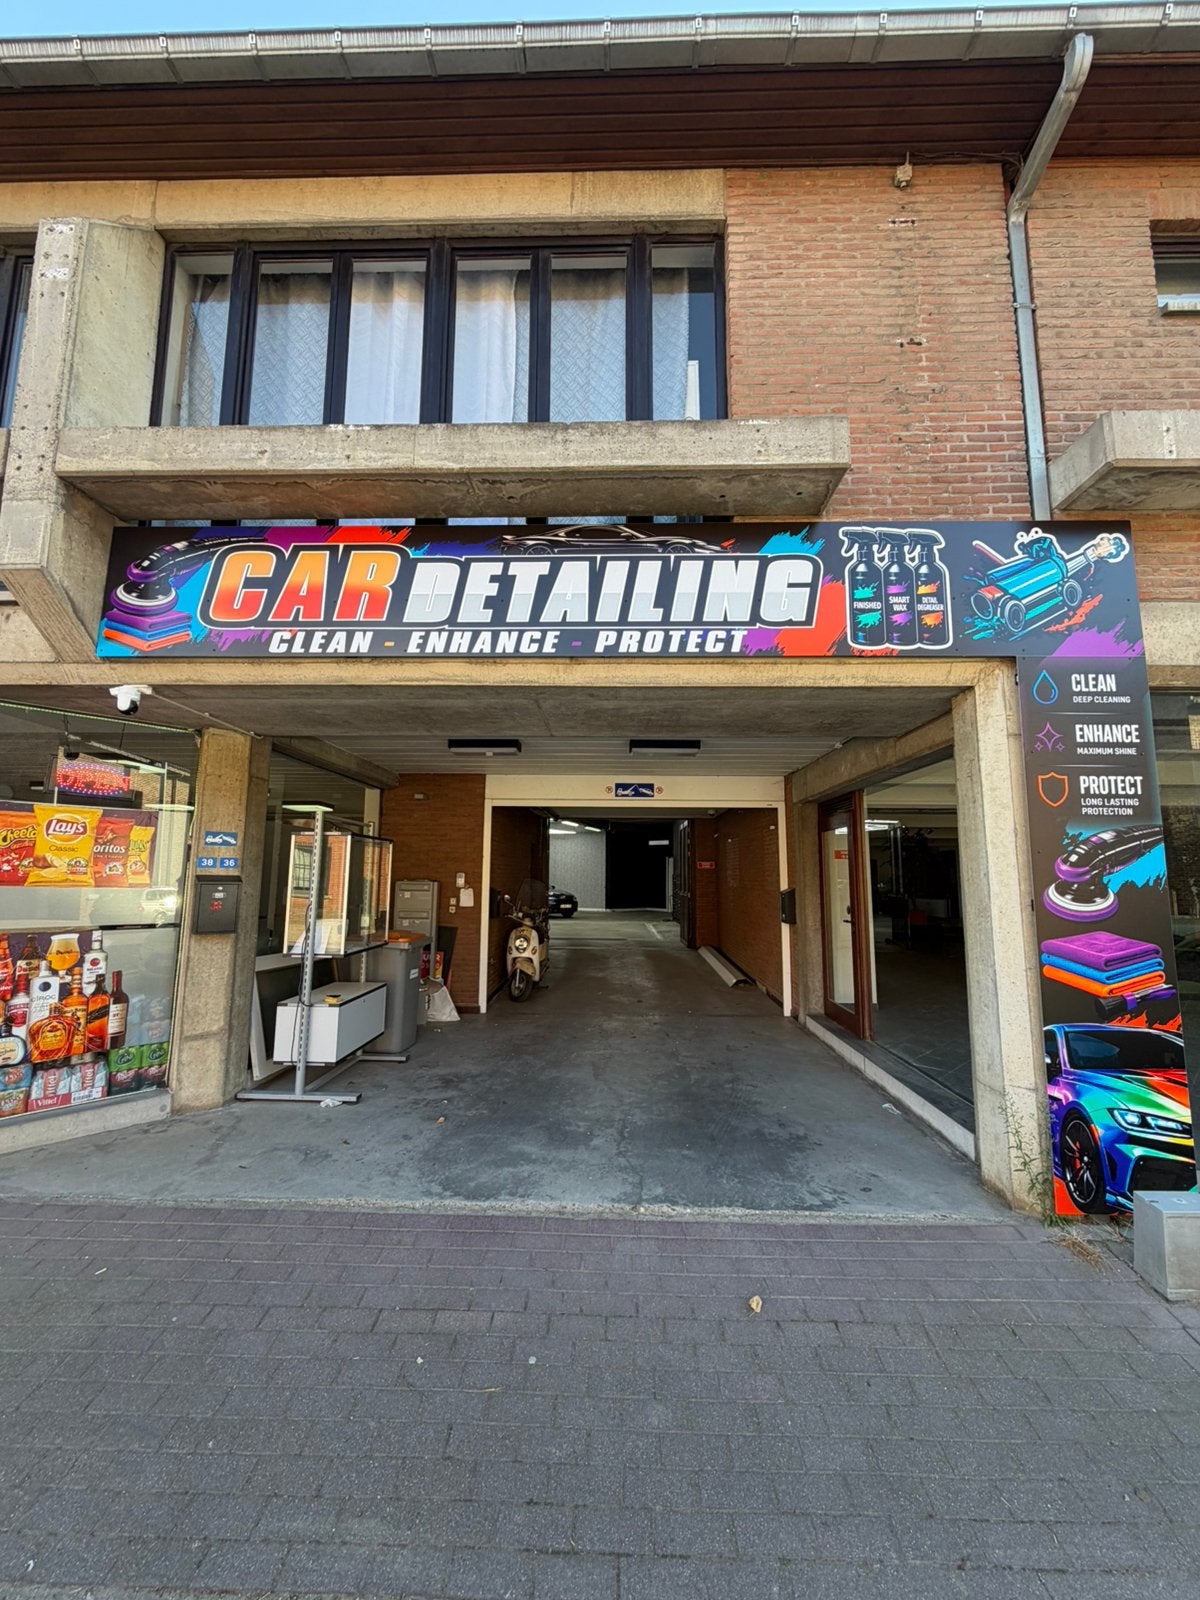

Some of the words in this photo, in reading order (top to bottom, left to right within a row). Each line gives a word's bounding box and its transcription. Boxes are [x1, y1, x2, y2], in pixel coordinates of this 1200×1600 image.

[208, 549, 401, 623] CAR
[402, 558, 816, 625] DETAILING
[888, 596, 911, 604] SMART
[853, 601, 882, 610] FINISHED
[892, 604, 908, 612] WAX
[268, 630, 374, 654] CLEAN
[406, 630, 561, 654] ENHANCE
[594, 629, 748, 654] PROTECT
[1071, 673, 1117, 692] CLEAN
[1072, 696, 1093, 704] DEEP
[1093, 696, 1131, 704] CLEANING
[1074, 724, 1141, 743] ENHANCE
[1076, 747, 1114, 756] MAXIMUM
[1114, 747, 1138, 756] SHINE
[1079, 775, 1144, 796] PROTECT
[1080, 798, 1104, 807] LONG
[1104, 798, 1140, 807] LASTING
[1081, 807, 1134, 816] PROTECTION
[48, 844, 79, 853] Classic
